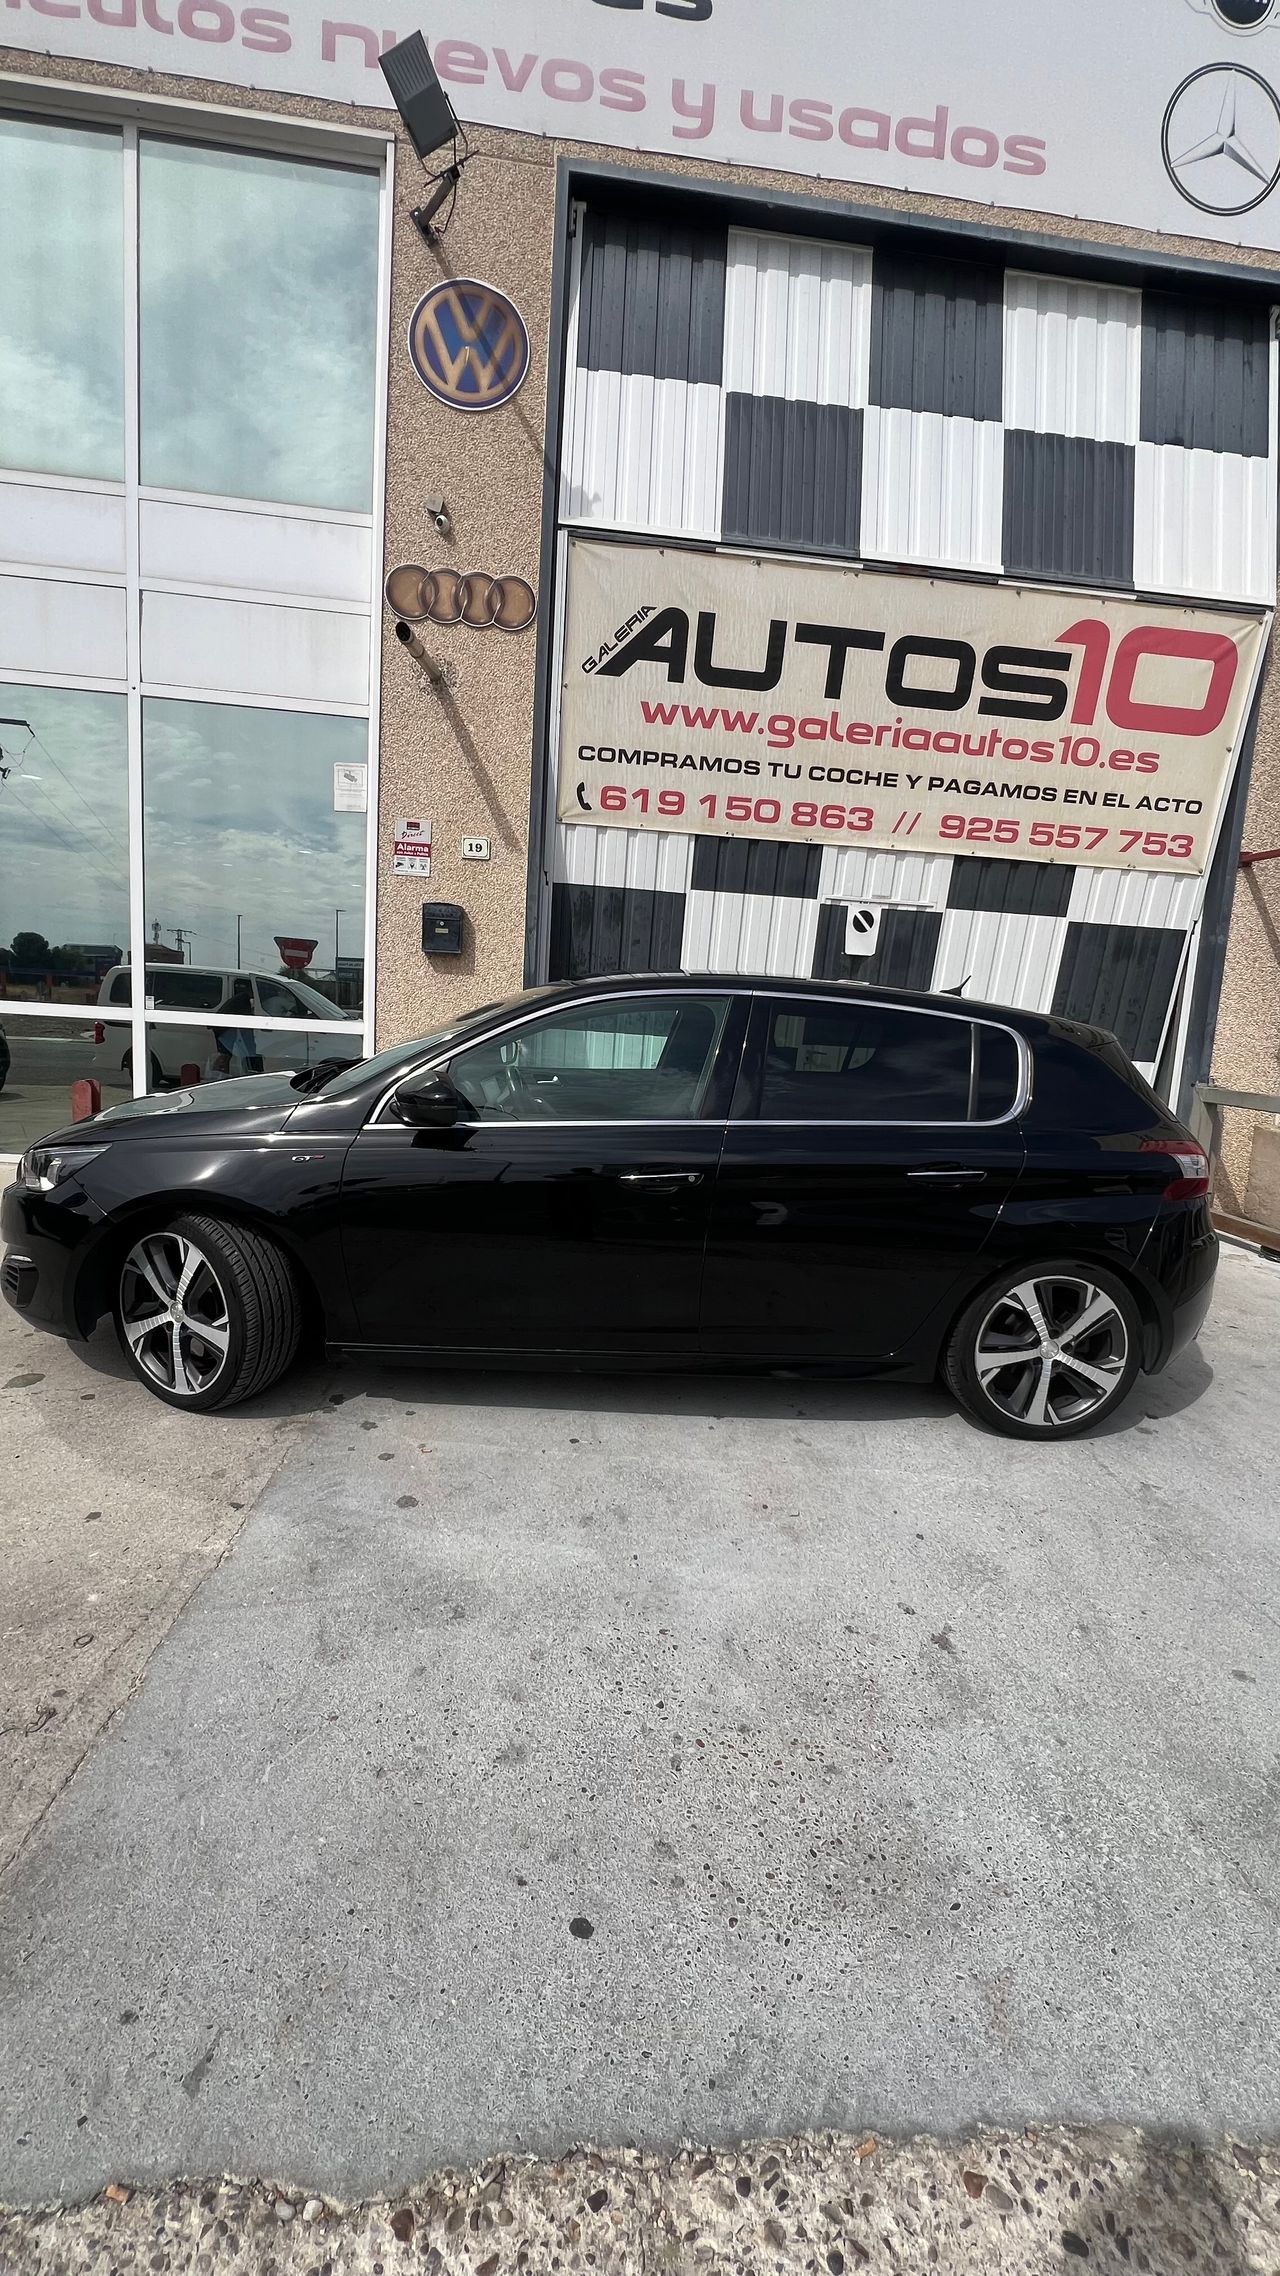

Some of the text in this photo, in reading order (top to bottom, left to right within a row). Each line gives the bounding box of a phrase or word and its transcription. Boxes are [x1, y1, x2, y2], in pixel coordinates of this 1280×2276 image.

[671, 78, 716, 140] y
[740, 88, 1047, 176] usados
[581, 605, 658, 674] GALERIA
[640, 700, 1161, 774] www.galeriaautos10.es
[577, 745, 1203, 815] COMPRAMOS TU COCHE Y PAGAMOS EN EL ACTO
[396, 842, 429, 852] Alarma
[468, 842, 483, 853] 19
[600, 785, 686, 816] 619
[699, 794, 782, 825] 150
[790, 802, 875, 833] 863
[938, 814, 1020, 844] 925
[1028, 822, 1109, 850] 557
[1118, 829, 1194, 858] 753
